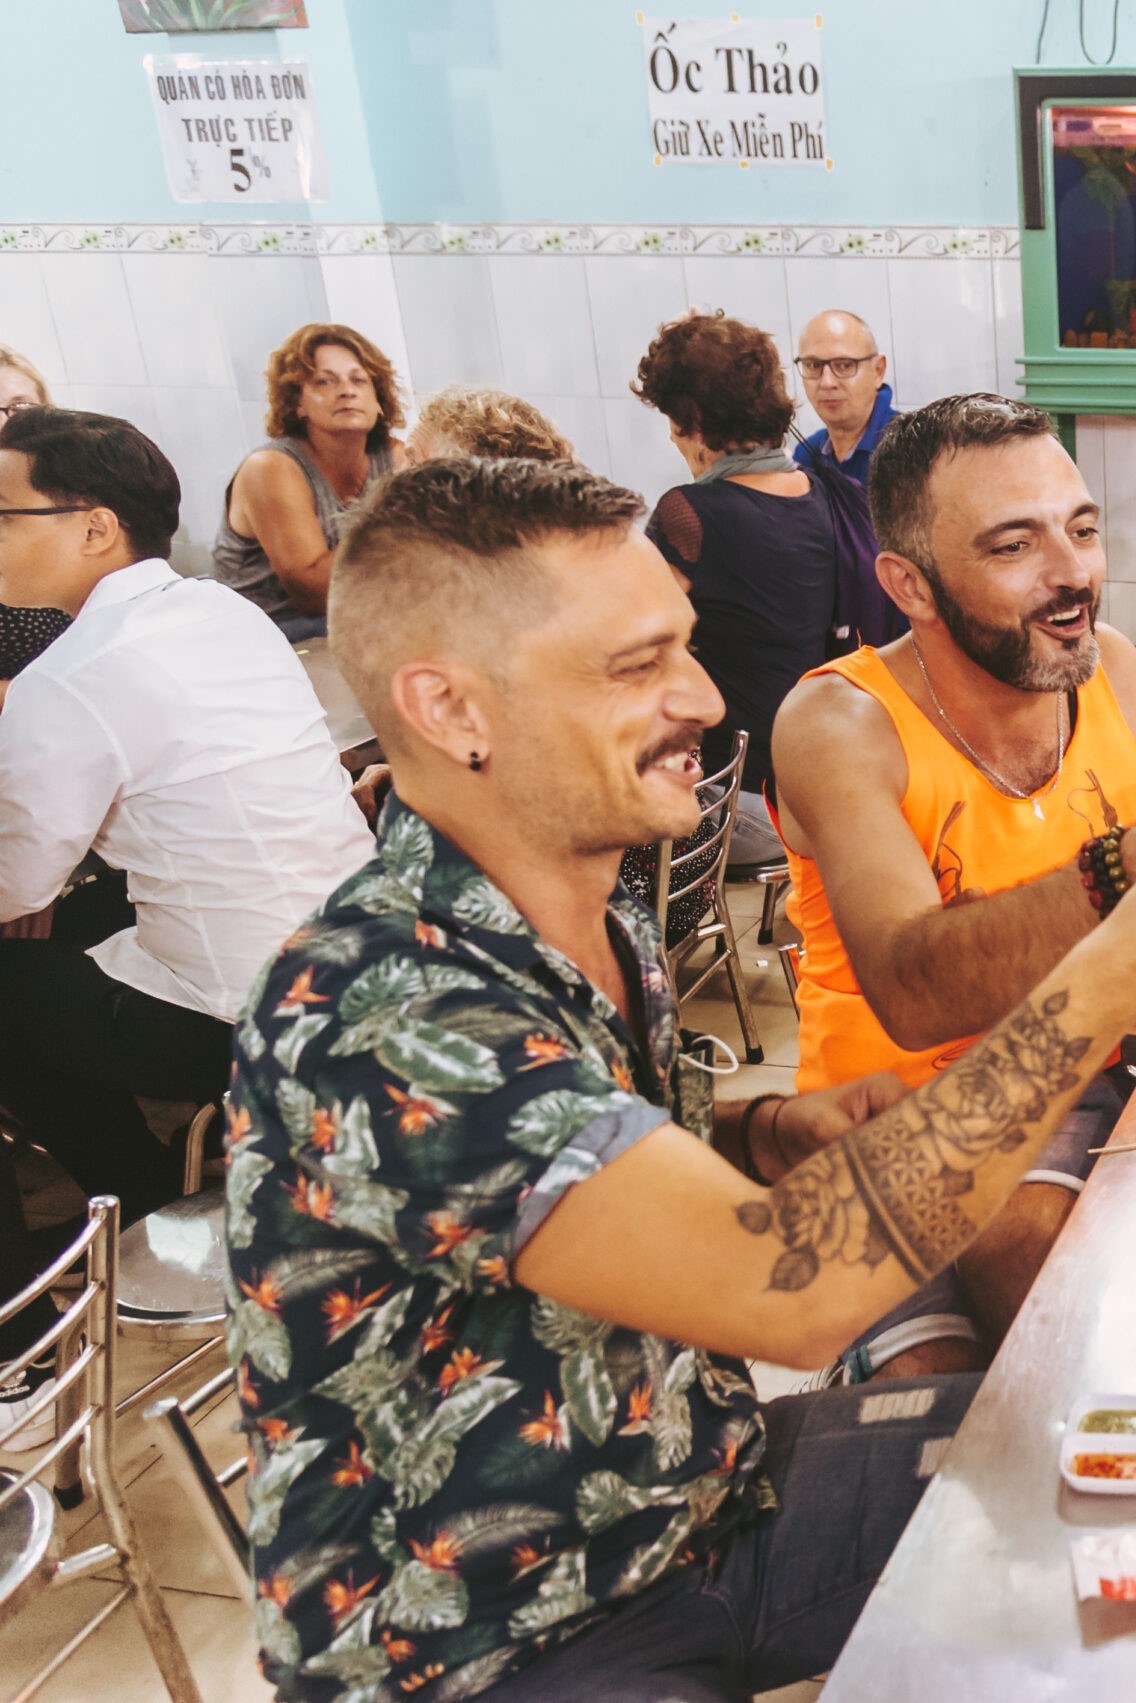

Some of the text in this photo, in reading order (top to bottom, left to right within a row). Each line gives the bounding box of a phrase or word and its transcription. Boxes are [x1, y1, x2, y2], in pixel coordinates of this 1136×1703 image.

[650, 22, 819, 95] Ốc Thảo
[270, 70, 306, 99] ĐƠN
[243, 110, 293, 142] TIẾP
[654, 113, 824, 159] Giữ Xe Miễn Phí
